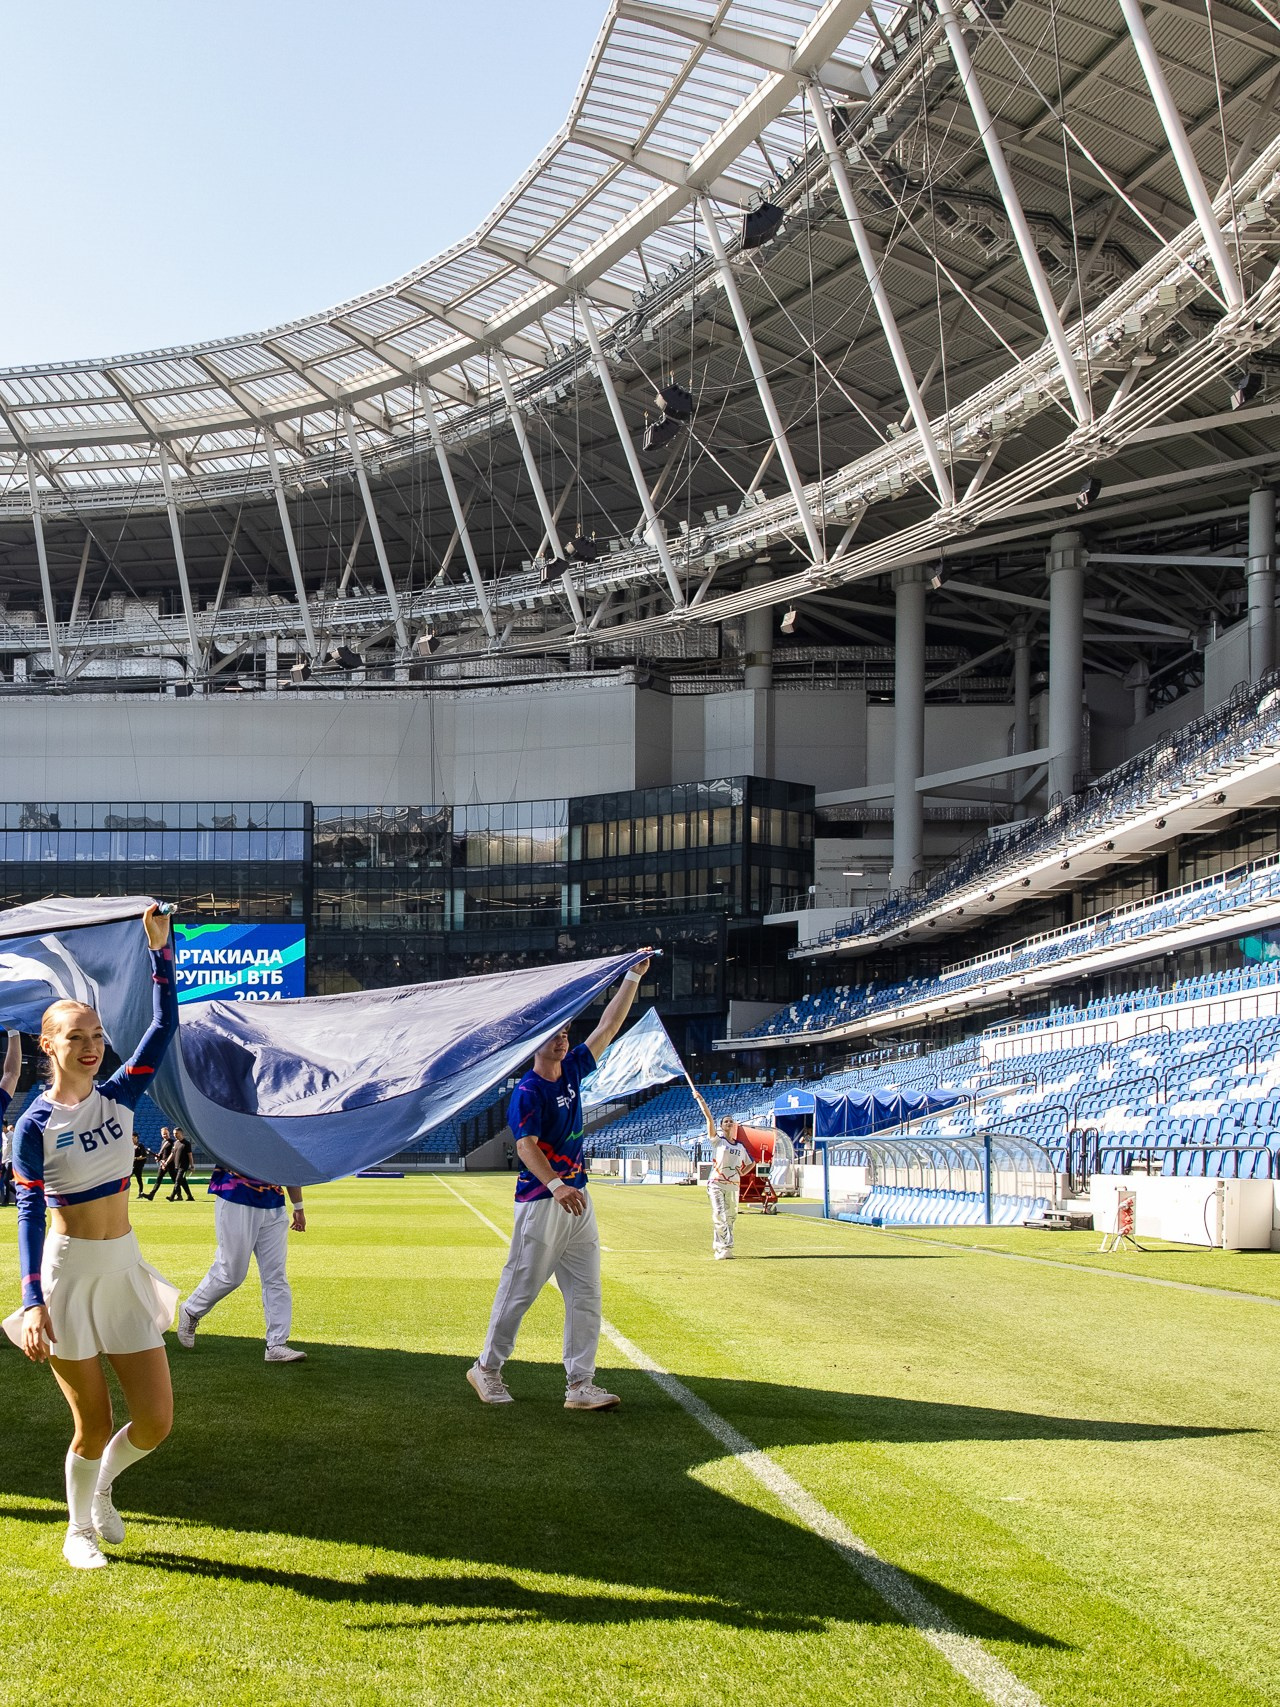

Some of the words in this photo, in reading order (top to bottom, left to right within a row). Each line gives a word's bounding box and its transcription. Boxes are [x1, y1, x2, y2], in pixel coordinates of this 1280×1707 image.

[247, 969, 284, 985] ВТБ
[234, 990, 282, 1001] 2024
[78, 1116, 124, 1153] ВТБ
